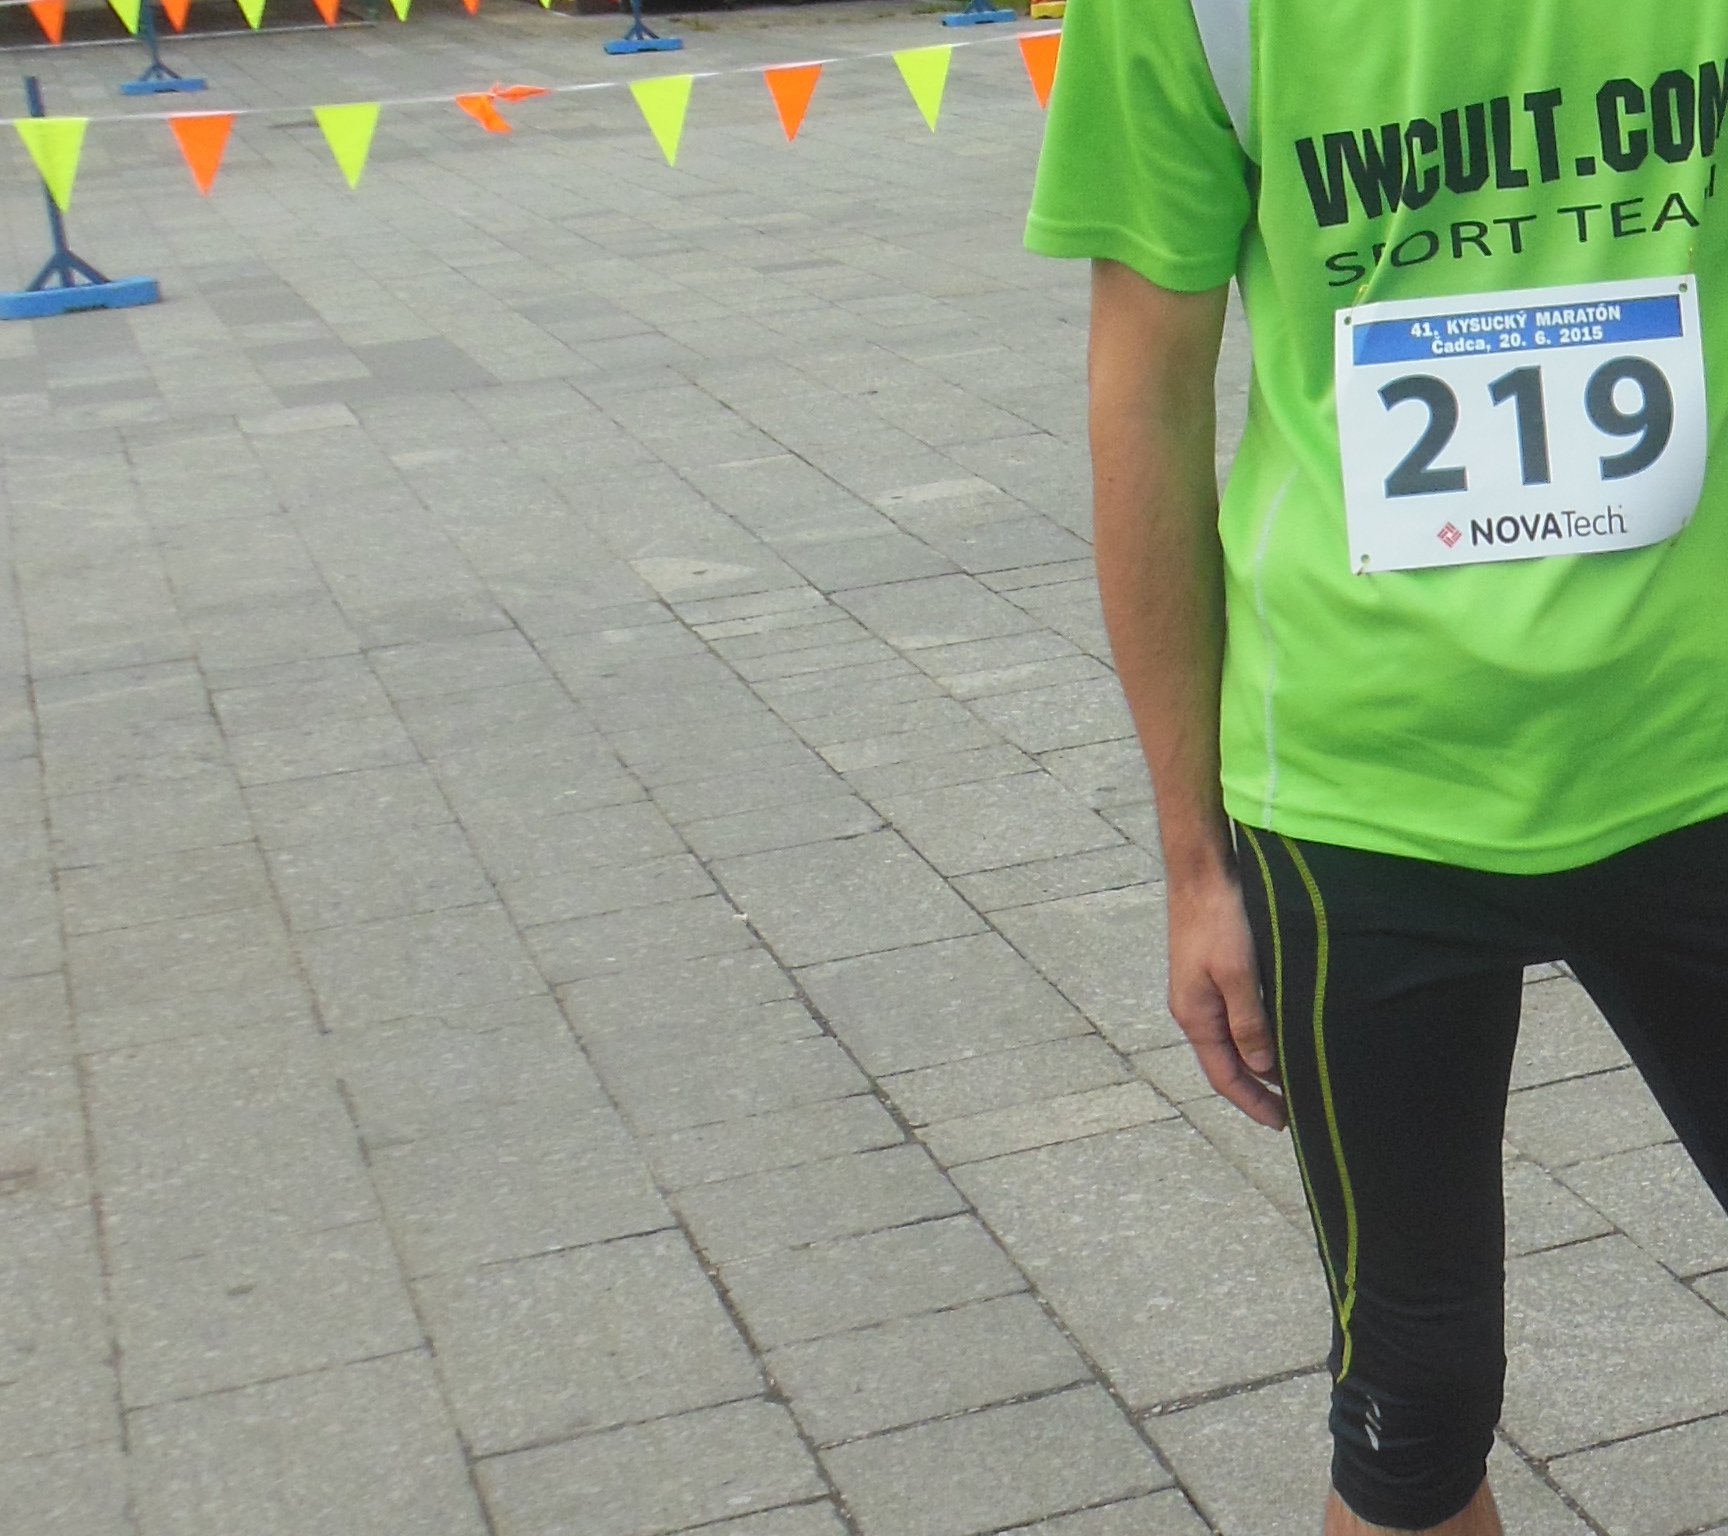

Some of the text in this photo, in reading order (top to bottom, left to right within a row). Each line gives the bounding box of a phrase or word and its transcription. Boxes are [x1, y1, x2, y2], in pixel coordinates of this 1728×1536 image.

[1557, 164, 1716, 243] TEA
[1410, 303, 1622, 338] 41. KYSUCKÝ MARATÓN
[1431, 325, 1604, 354] Čadca, 20. 6. 2015
[1376, 355, 1675, 500] 219
[1470, 505, 1628, 547] NOVATech
